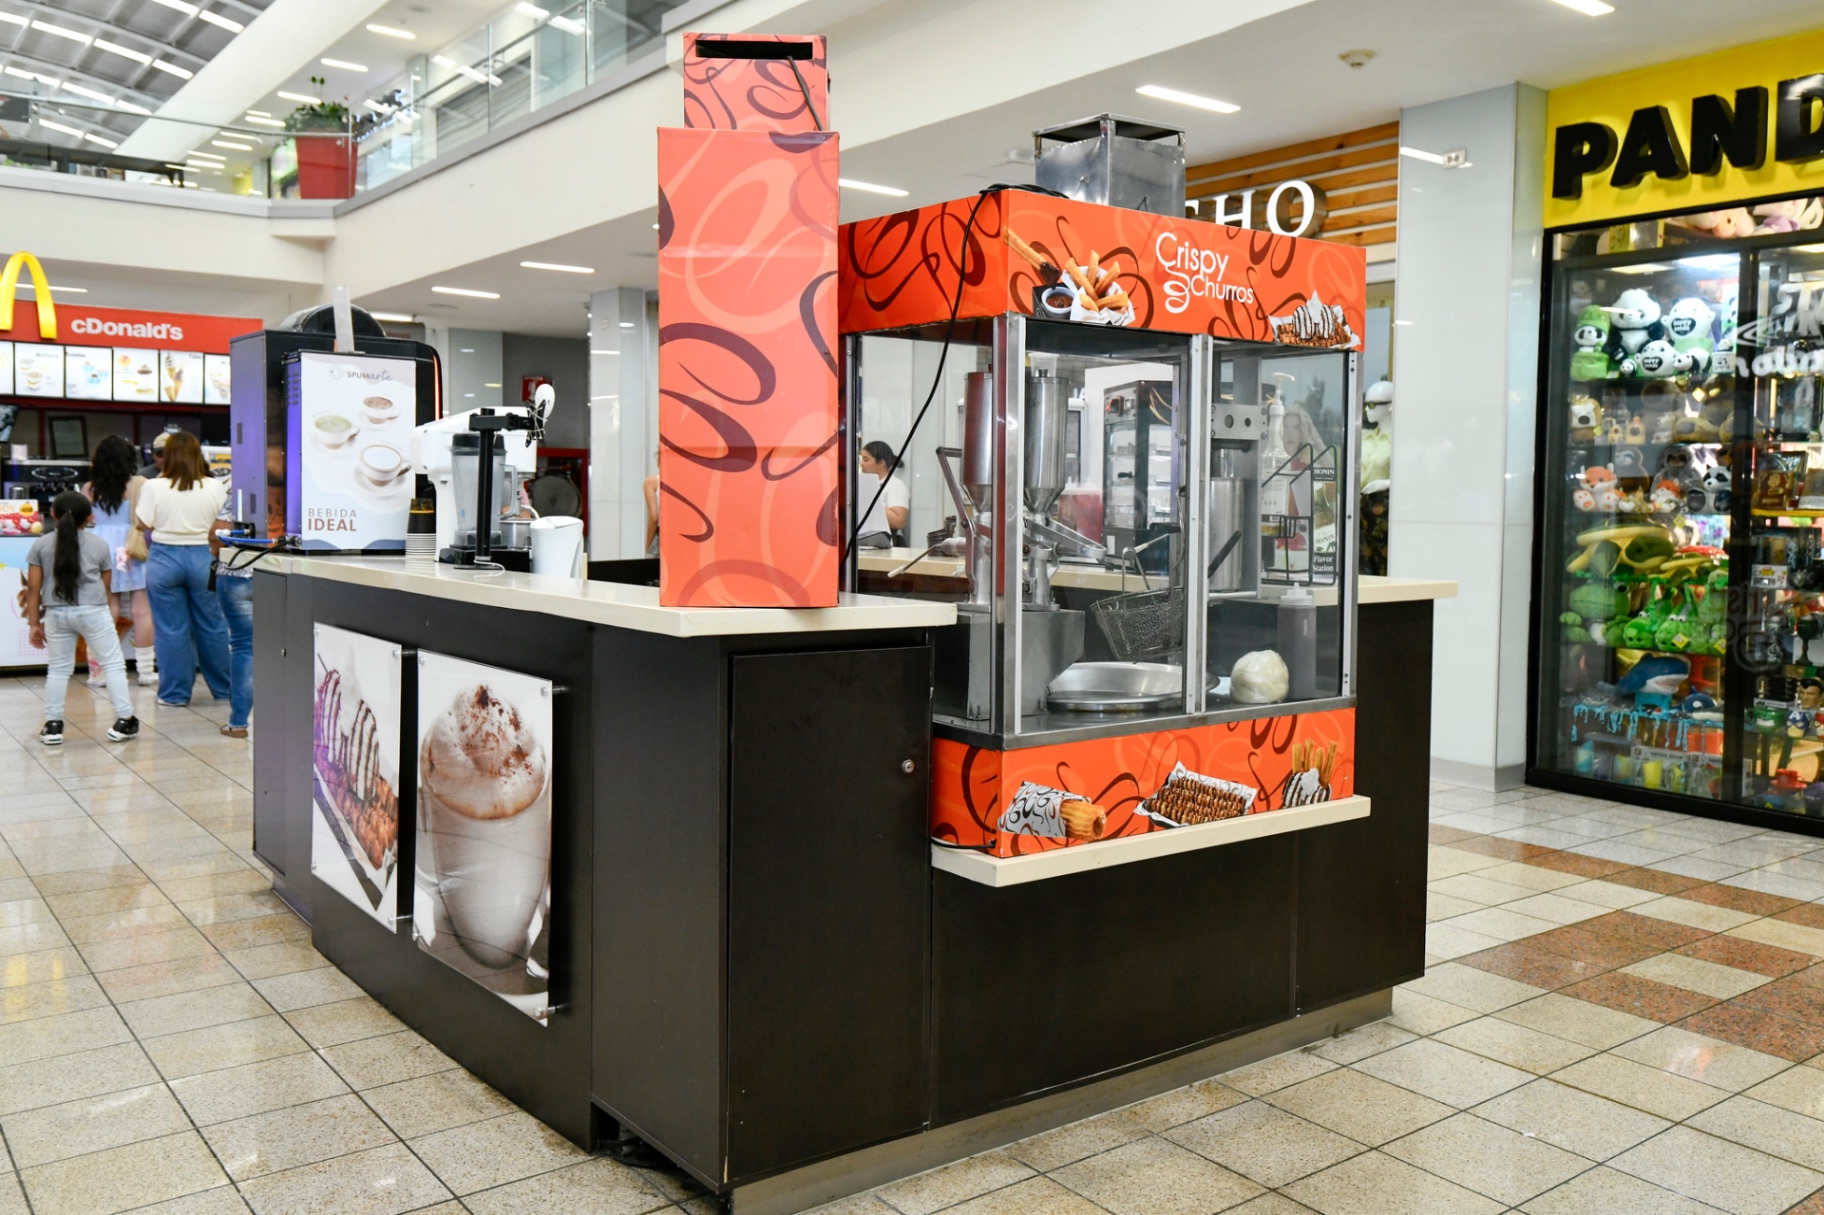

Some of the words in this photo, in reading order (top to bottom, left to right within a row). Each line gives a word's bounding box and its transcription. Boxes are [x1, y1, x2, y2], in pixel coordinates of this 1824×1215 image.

[1156, 232, 1229, 281] Crispy
[1190, 275, 1254, 304] Churros
[71, 317, 183, 340] cDonald's
[1313, 468, 1335, 476] MONIN
[308, 508, 357, 518] BEBIDA
[308, 518, 357, 532] IDEAL
[1313, 555, 1333, 564] Flavor
[1313, 563, 1334, 573] Station
